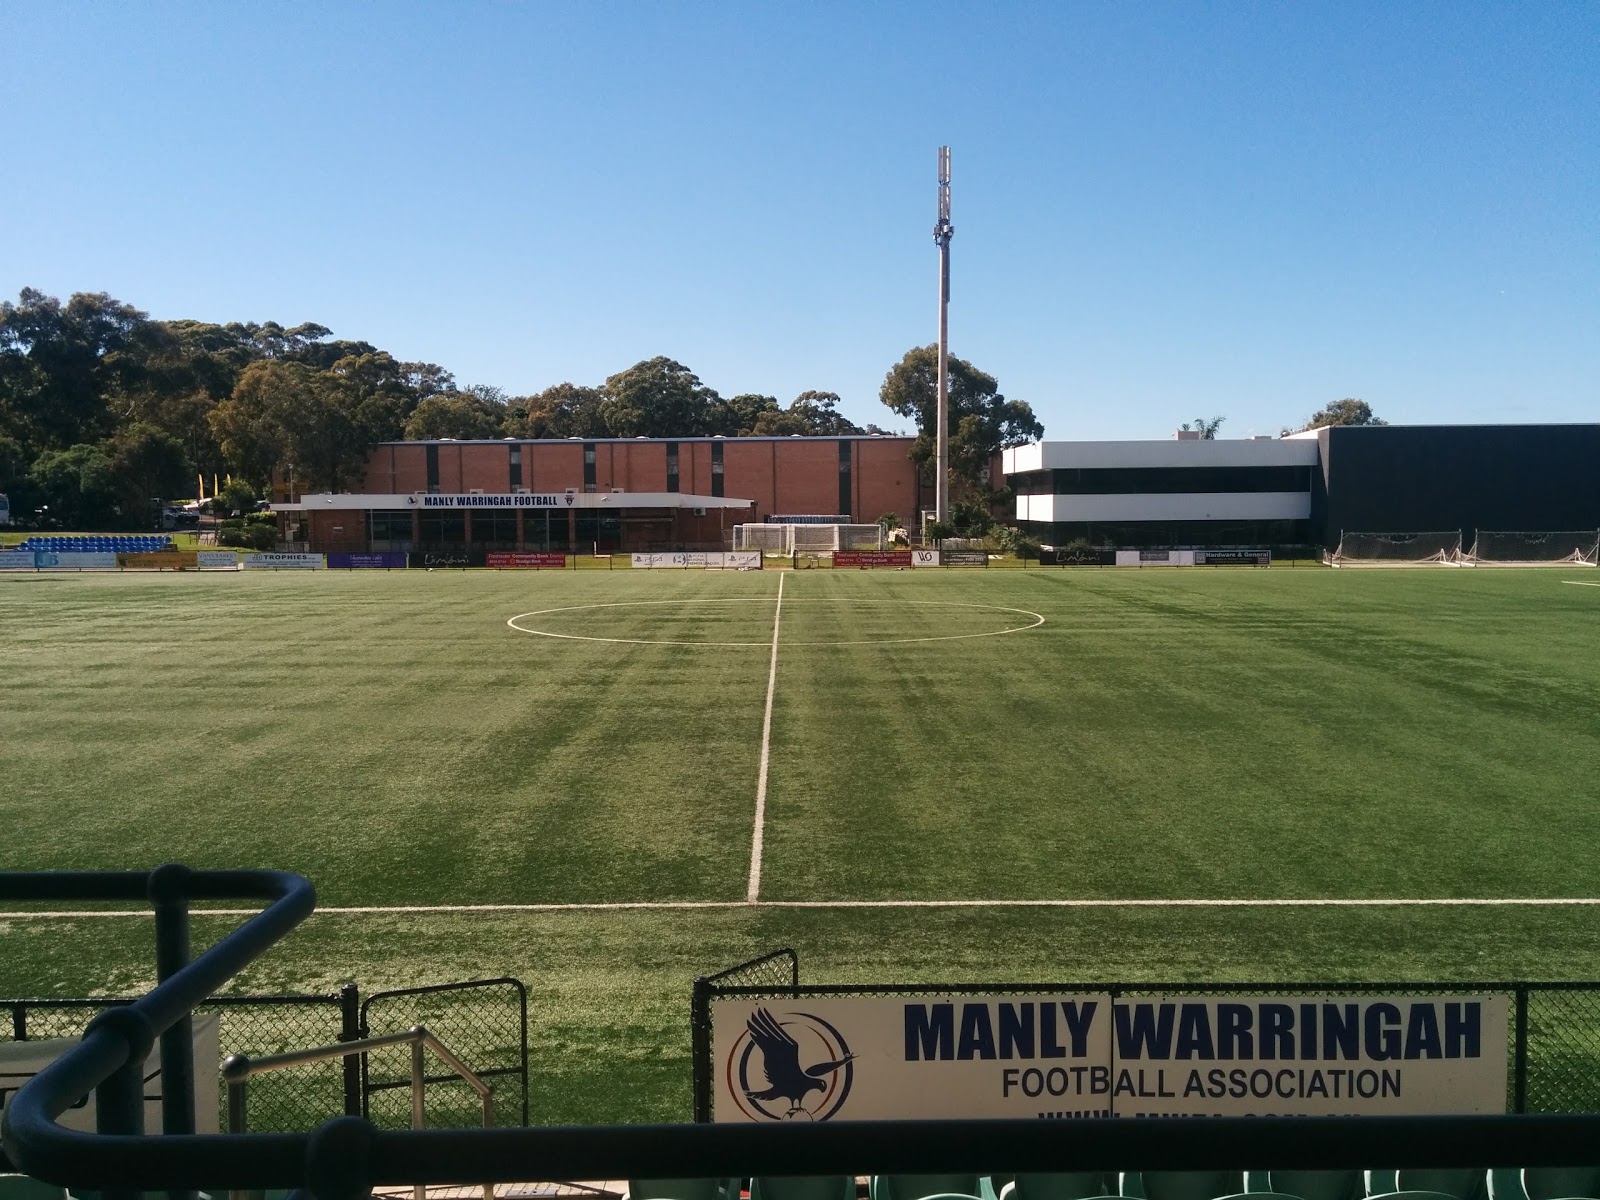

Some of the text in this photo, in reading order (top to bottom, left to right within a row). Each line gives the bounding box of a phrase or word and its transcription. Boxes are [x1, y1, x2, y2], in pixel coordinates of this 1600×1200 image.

[424, 496, 558, 506] MANLY WARRINGAH FOOTBALL
[904, 1002, 1482, 1061] MANLY WARRINGAH
[1003, 1066, 1402, 1099] FOOTBALL ASSOCIATION
